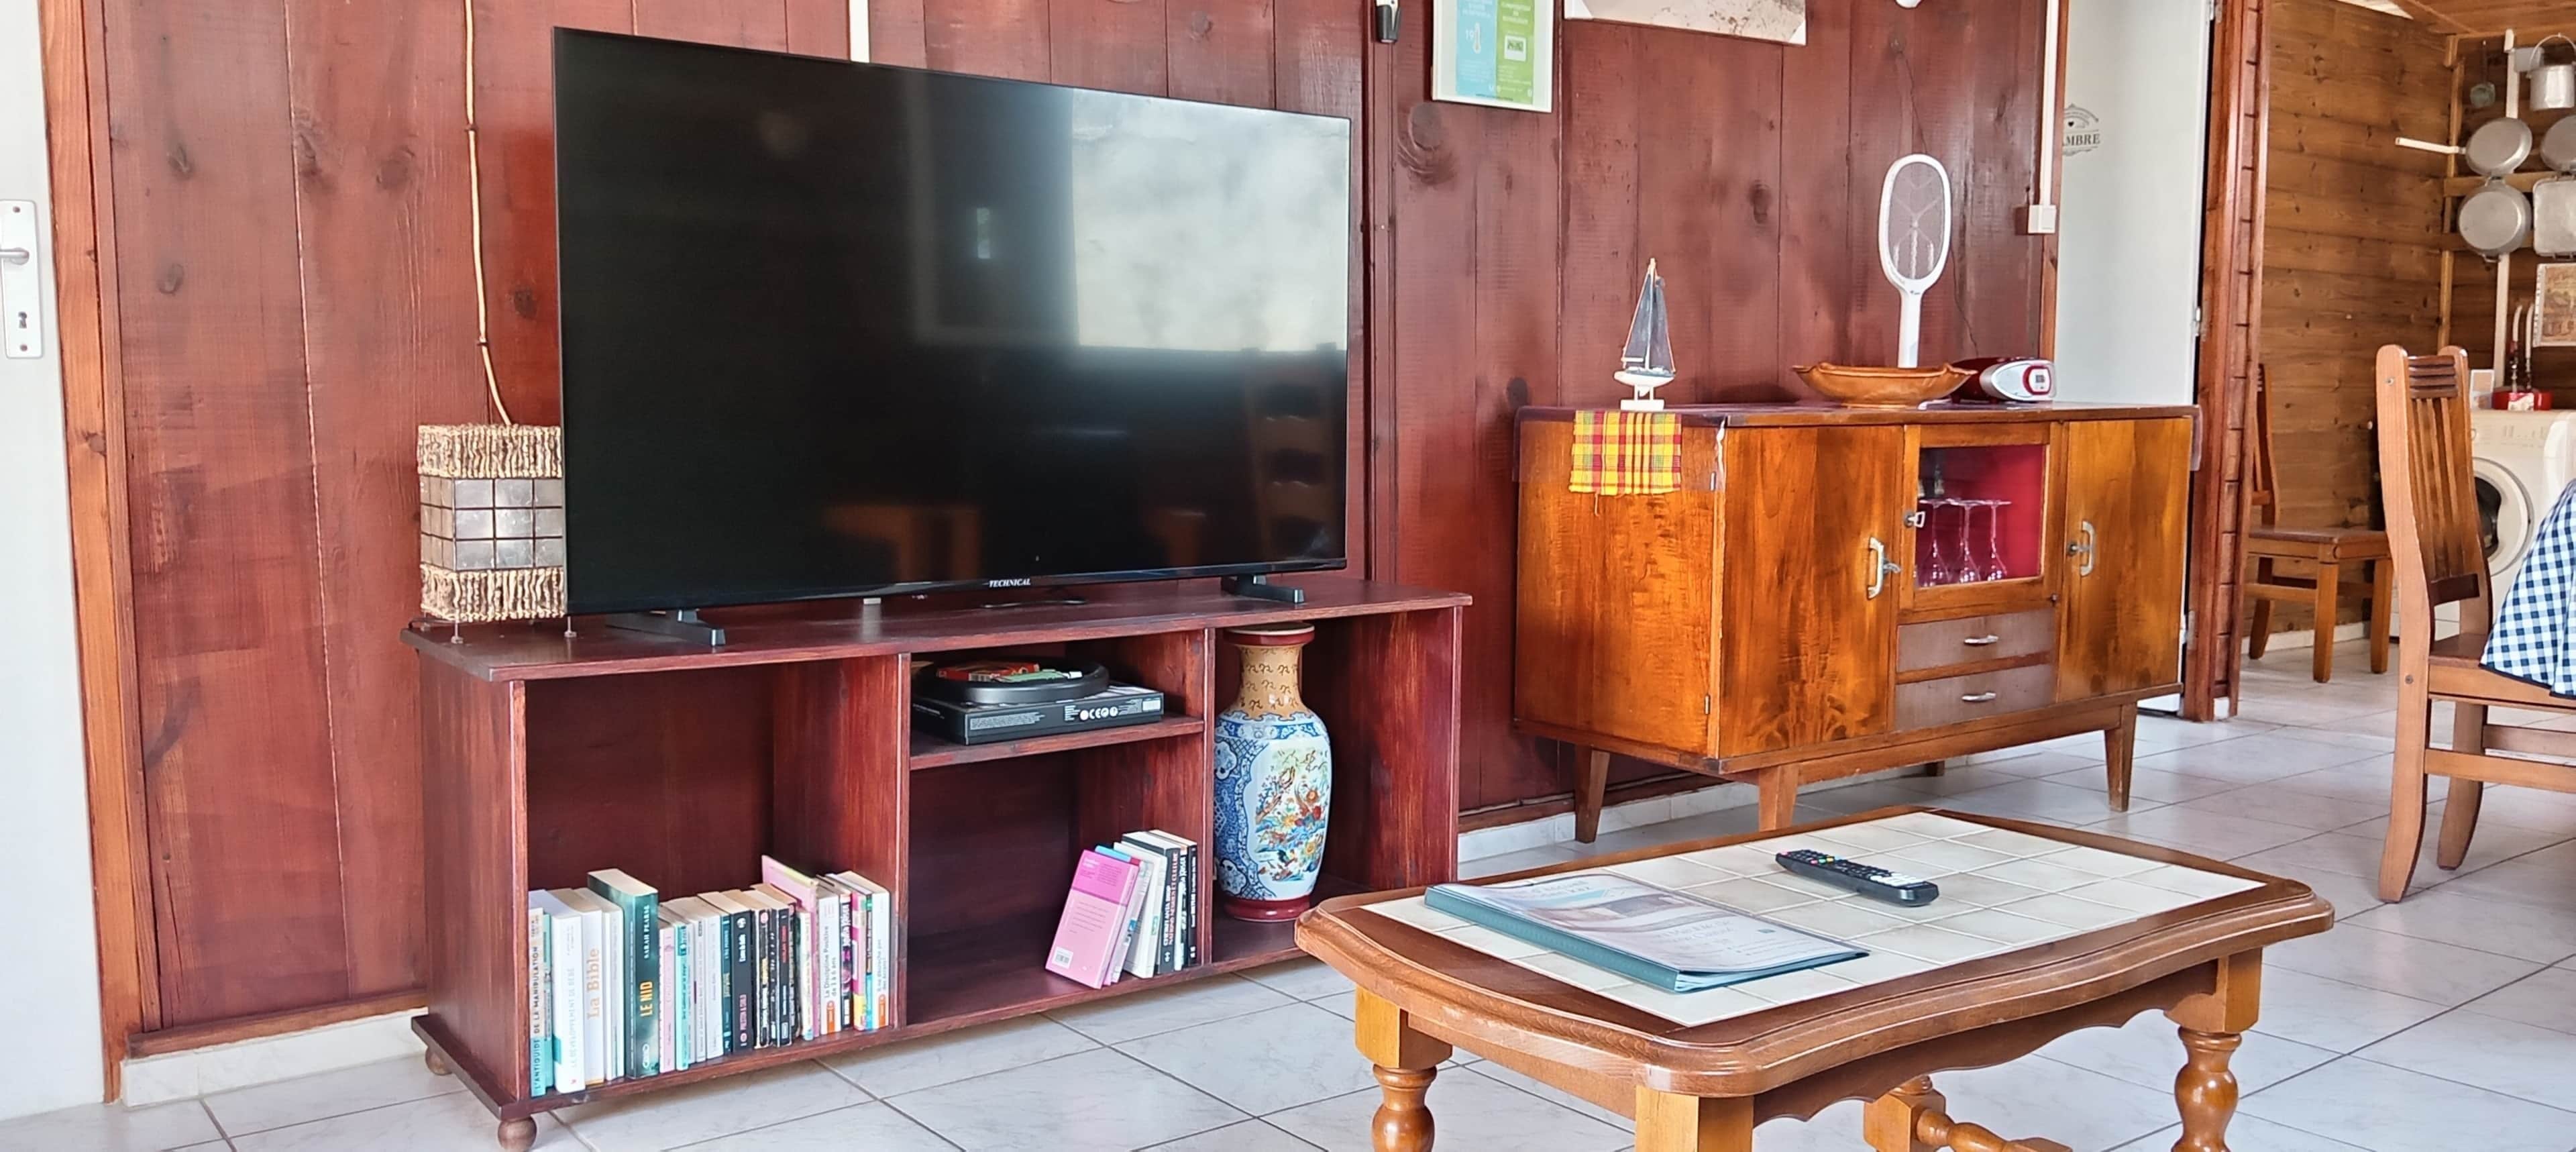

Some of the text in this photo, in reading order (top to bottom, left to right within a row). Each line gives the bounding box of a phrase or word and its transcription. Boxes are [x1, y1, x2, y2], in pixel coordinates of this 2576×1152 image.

[989, 578, 1031, 588] TECHNICAL
[823, 955, 831, 988] Discipline
[586, 948, 600, 1019] La Bible
[639, 981, 653, 1017] LE NID
[533, 1010, 540, 1020] LA
[533, 1023, 540, 1034] DE
